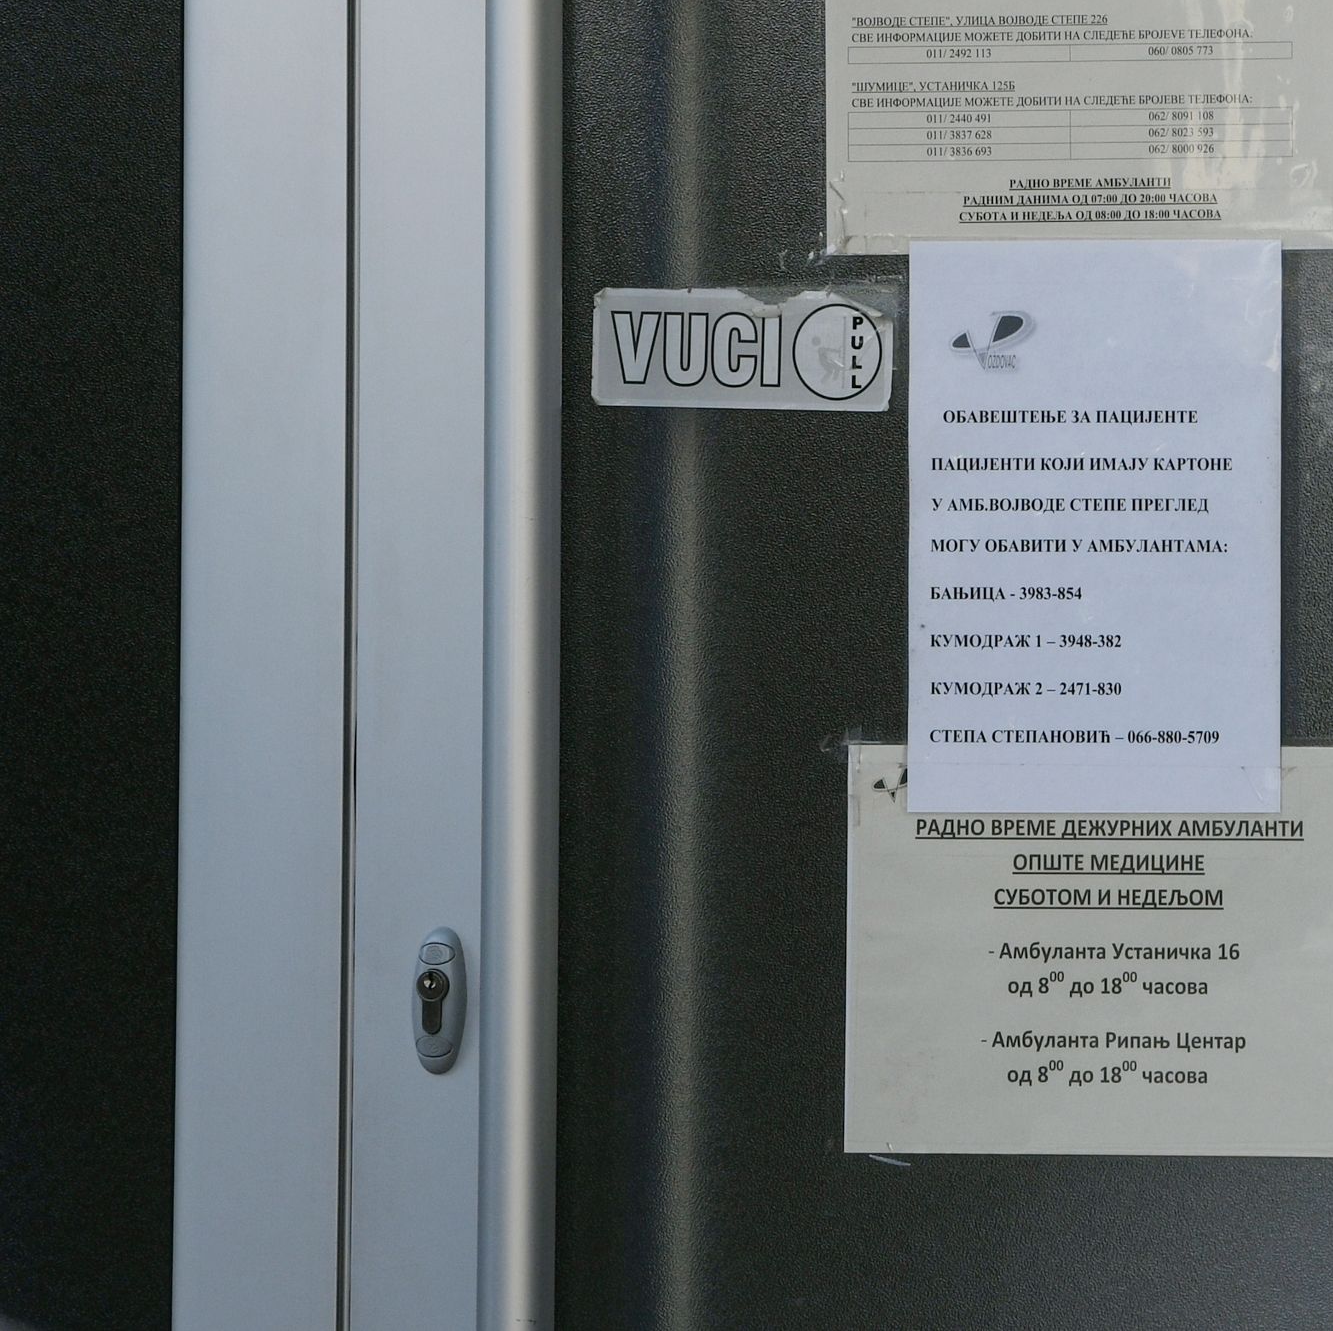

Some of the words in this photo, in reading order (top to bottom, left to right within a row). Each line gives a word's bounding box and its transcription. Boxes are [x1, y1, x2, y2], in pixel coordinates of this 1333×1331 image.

[955, 15, 996, 27] УЛИЦА
[998, 15, 1049, 26] ВОЈВОДЕ
[1051, 14, 1089, 25] СТЕПЕ
[1091, 14, 1108, 25] 226
[918, 80, 988, 91] УСТАНИЧКА
[989, 80, 1015, 91] 125Б
[1009, 178, 1049, 187] РАДНО
[1053, 178, 1092, 187] ВРЕМЕ
[1095, 177, 1170, 187] АМБУЛАНТИ
[963, 194, 1013, 205] РАДНИМ
[1016, 194, 1068, 204] ДАНИМА
[1071, 194, 1088, 204] ОД
[1091, 194, 1117, 203] 07:00
[1119, 193, 1137, 204] ДО
[1139, 193, 1165, 204] 20:00
[1169, 192, 1217, 203] ЧАСОВА
[959, 211, 1007, 221] СУБОТА
[1010, 211, 1018, 220] И
[1022, 210, 1072, 221] НЕДЕЉА
[1075, 210, 1093, 220] ОД
[1094, 209, 1121, 220] 08:00
[1122, 209, 1142, 220] ДО
[1143, 209, 1171, 220] 18:00
[1173, 209, 1221, 220] ЧАСОВА
[611, 311, 782, 388] VUCI
[850, 316, 864, 389] PULL
[942, 409, 1066, 424] ОБАВЕШТЕЊЕ
[1071, 409, 1091, 423] ЗА
[1096, 410, 1197, 426] ПАЦИЈЕНТЕ
[931, 457, 1035, 473] ПАЦИЈЕНТИ
[1040, 457, 1084, 471] КОЈИ
[1089, 457, 1148, 471] ИМАЈУ
[1153, 457, 1232, 471] КАРТОНЕ
[931, 497, 942, 511] У
[947, 497, 1065, 514] АМБ.ВОЈВОДЕ
[1069, 497, 1126, 511] СТЕПЕ
[1131, 497, 1208, 513] ПРЕГЛЕД
[931, 538, 980, 552] МОГУ
[984, 538, 1066, 552] ОБАВИТИ
[1071, 539, 1082, 552] У
[1087, 539, 1227, 553] АМБУЛАНТАМА:
[930, 586, 1005, 602] БАЊИЦА
[1019, 586, 1082, 600] 3983-854
[930, 634, 1030, 650] КУМОДРАЖ
[1036, 634, 1040, 647] 1
[1058, 634, 1121, 648] 3948-382
[930, 681, 1031, 698] КУМОДРАЖ
[1035, 682, 1042, 695] 2
[1059, 681, 1121, 696] 2471-830
[929, 729, 987, 743] СТЕПА
[991, 729, 1110, 743] СТЕПАНОВИЋ
[1127, 730, 1219, 743] 066-880-5709
[916, 818, 985, 837] РАДНО
[991, 819, 1056, 836] ВРЕМЕ
[1061, 819, 1172, 838] ДЕЖУРНИХ
[1177, 819, 1303, 837] АМБУЛАНТИ
[1012, 853, 1084, 870] ОПШТЕ
[1090, 853, 1204, 872] МЕДИЦИНЕ
[994, 888, 1091, 905] СУБОТОМ
[1098, 888, 1110, 905] И
[1117, 888, 1222, 906] НЕДЕЉОМ
[998, 941, 1106, 961] Амбуланта
[1111, 942, 1211, 960] Устаничка
[1218, 943, 1240, 960] 16
[1007, 980, 1033, 997] од
[1069, 981, 1094, 998] до
[1142, 981, 1208, 995] часова
[991, 1031, 1098, 1052] Амбуланта
[1105, 1031, 1170, 1049] Рипањ
[1176, 1031, 1246, 1053] Центар
[1007, 1069, 1032, 1087] од
[1068, 1070, 1094, 1087] до
[1141, 1070, 1207, 1084] часова
